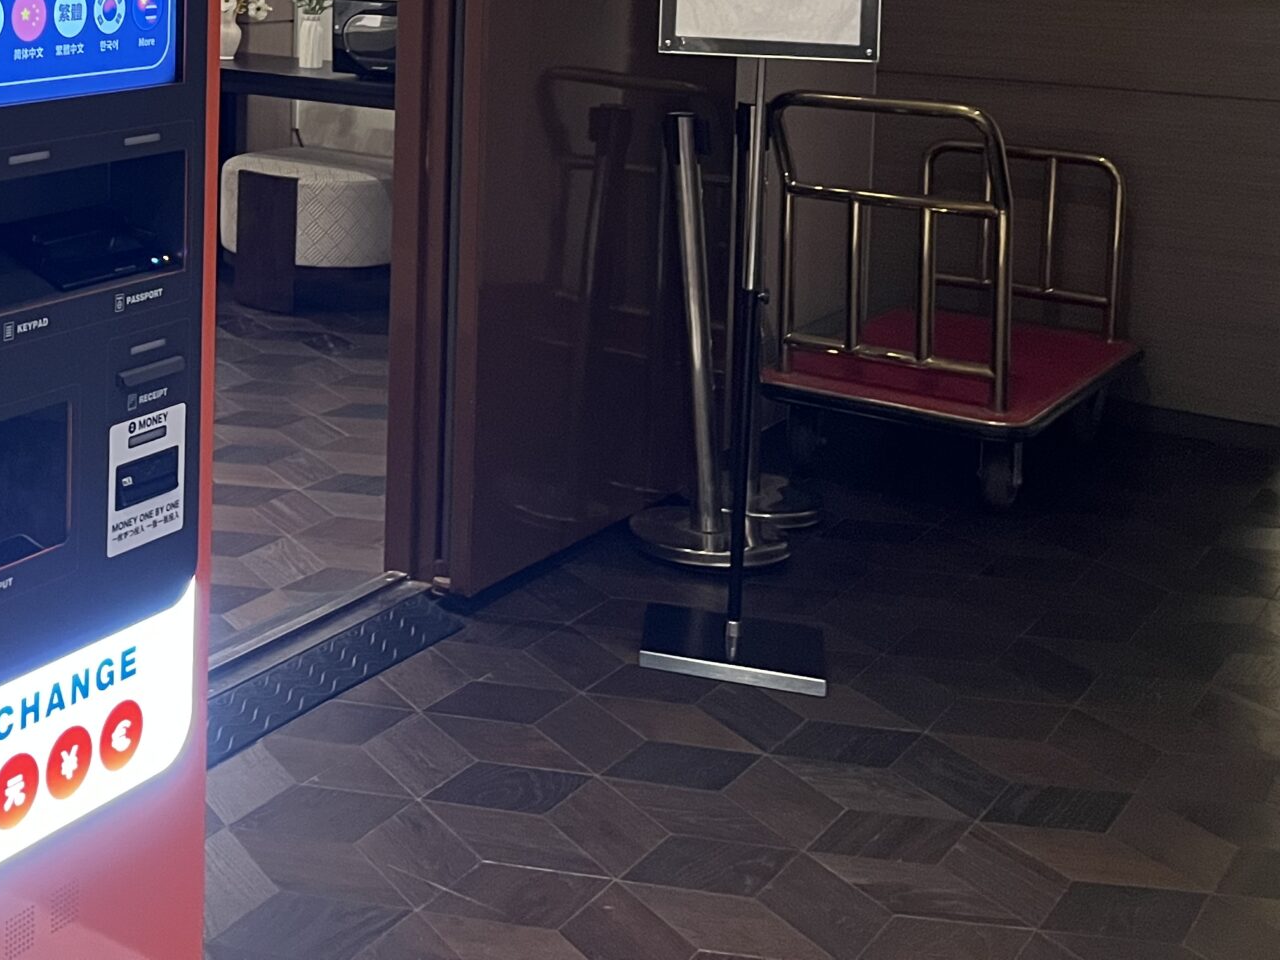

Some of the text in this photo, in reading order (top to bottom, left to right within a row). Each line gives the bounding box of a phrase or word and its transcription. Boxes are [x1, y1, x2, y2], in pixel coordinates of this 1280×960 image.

[99, 39, 119, 52] 한국어
[138, 37, 155, 47] More
[126, 288, 163, 305] PASSPORT
[17, 317, 48, 334] KEYPAD
[138, 387, 168, 404] RECEIPT
[138, 411, 168, 430] MONEY
[112, 499, 180, 533] MONEY ONE BY ONE
